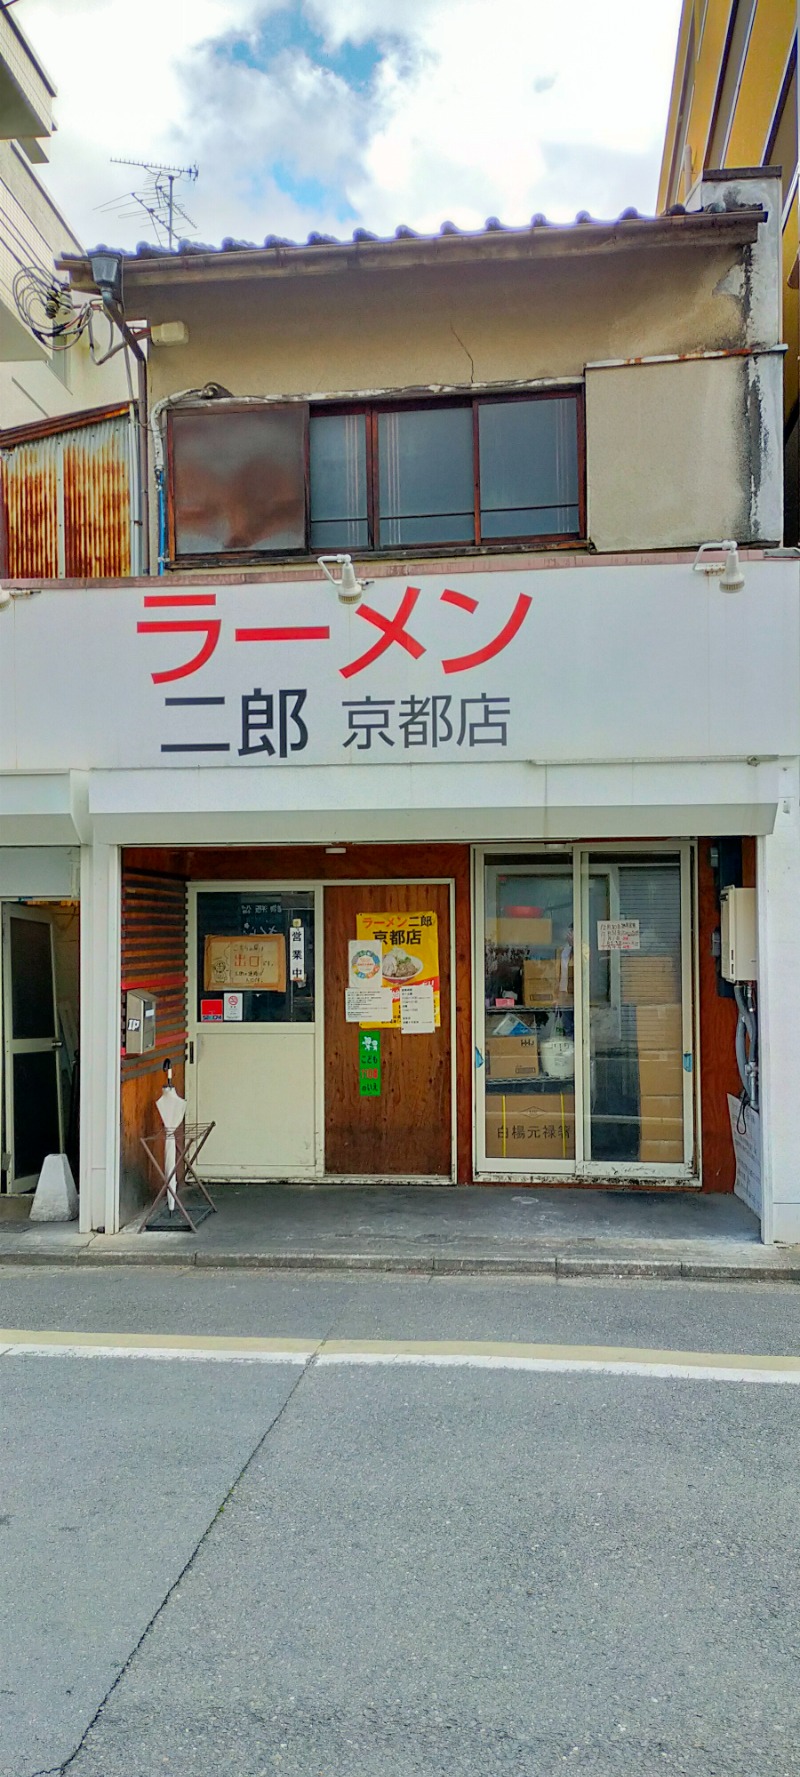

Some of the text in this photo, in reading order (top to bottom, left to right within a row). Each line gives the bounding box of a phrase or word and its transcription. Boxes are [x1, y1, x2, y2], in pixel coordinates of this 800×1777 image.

[136, 586, 533, 684] ラーメン
[160, 688, 511, 758] 二郎 京都店
[362, 915, 433, 928] ラーメン二郎
[373, 929, 422, 946] 京都店
[292, 930, 303, 978] 営業中
[361, 1055, 378, 1064] こども
